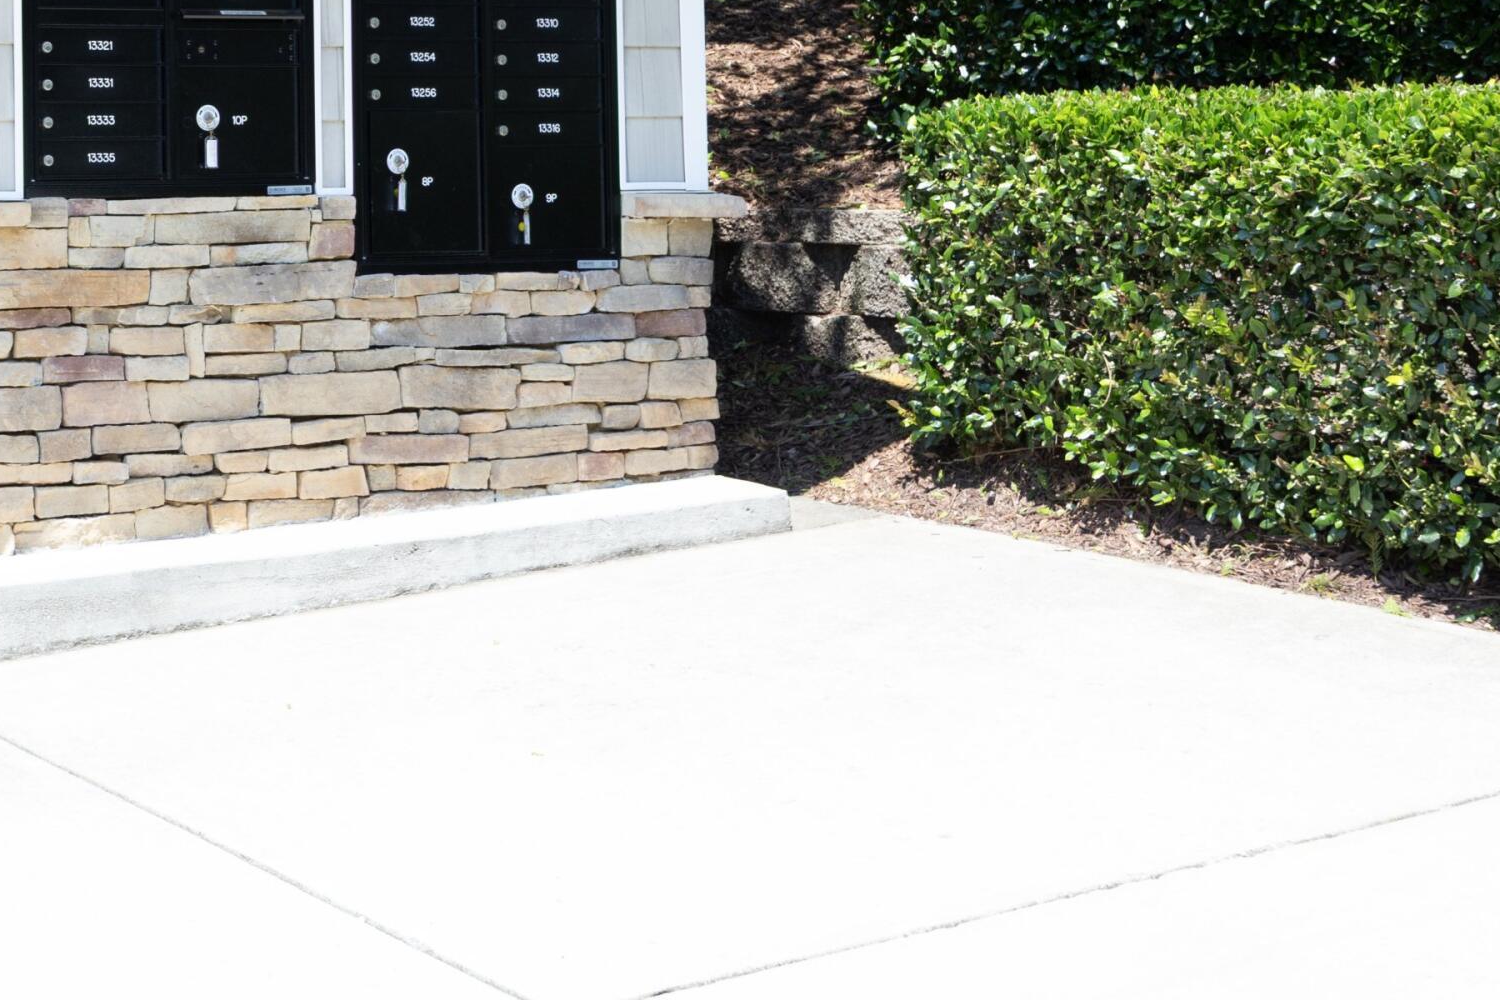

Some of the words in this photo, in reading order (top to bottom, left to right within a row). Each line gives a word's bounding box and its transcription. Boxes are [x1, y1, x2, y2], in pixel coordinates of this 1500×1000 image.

[409, 16, 435, 27] 13252
[535, 17, 559, 29] 13310
[87, 40, 114, 51] 13321
[409, 51, 436, 63] 13254
[536, 52, 560, 63] 13312
[87, 77, 114, 89] 13331
[410, 87, 437, 98] 13256
[537, 87, 560, 98] 13314
[86, 114, 116, 126] 13333
[231, 114, 249, 126] 10P
[538, 122, 561, 134] 13316
[87, 152, 116, 164] 13335
[421, 176, 434, 187] 8P
[545, 192, 558, 204] 9P
